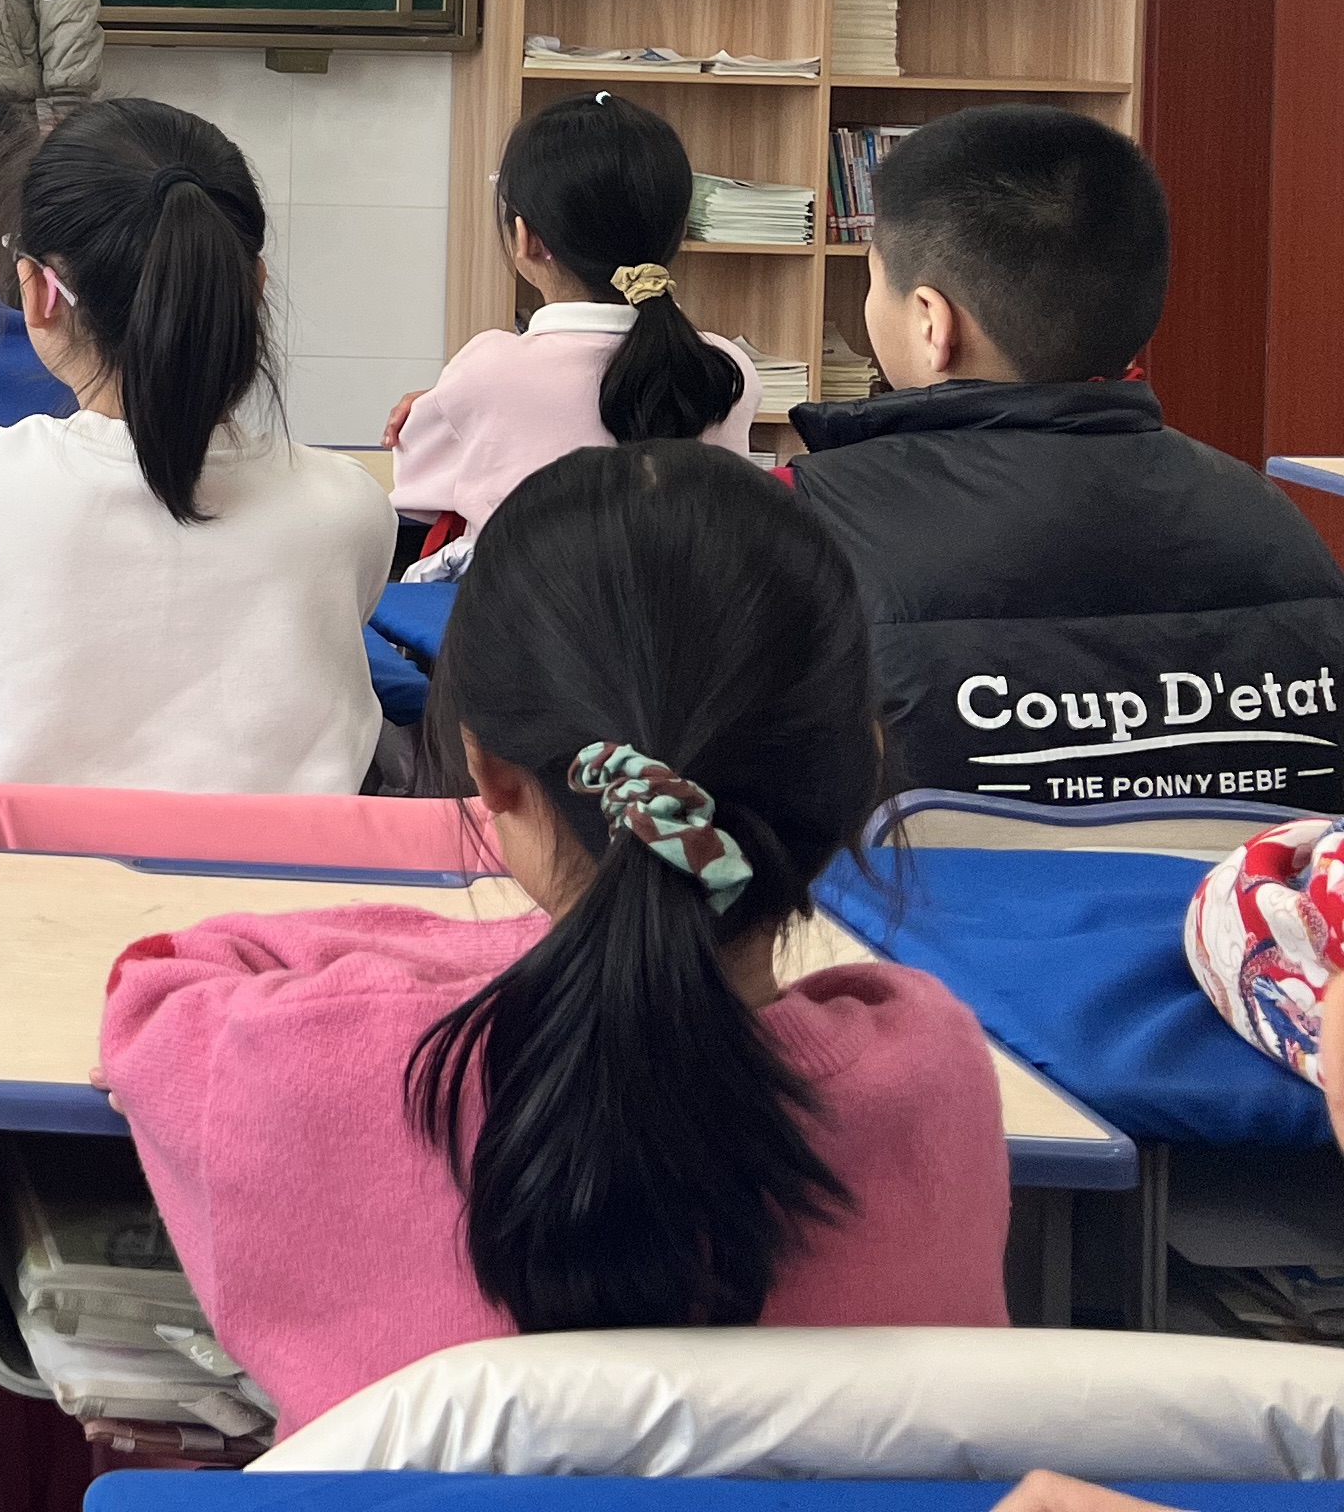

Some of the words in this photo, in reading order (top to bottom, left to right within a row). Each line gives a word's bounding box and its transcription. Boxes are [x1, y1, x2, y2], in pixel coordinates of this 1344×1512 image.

[956, 675, 1148, 742] Coup
[1159, 666, 1337, 726] D'etat
[1047, 777, 1103, 799] THE
[1113, 773, 1213, 798] PONNY
[1220, 767, 1287, 794] BEBE
